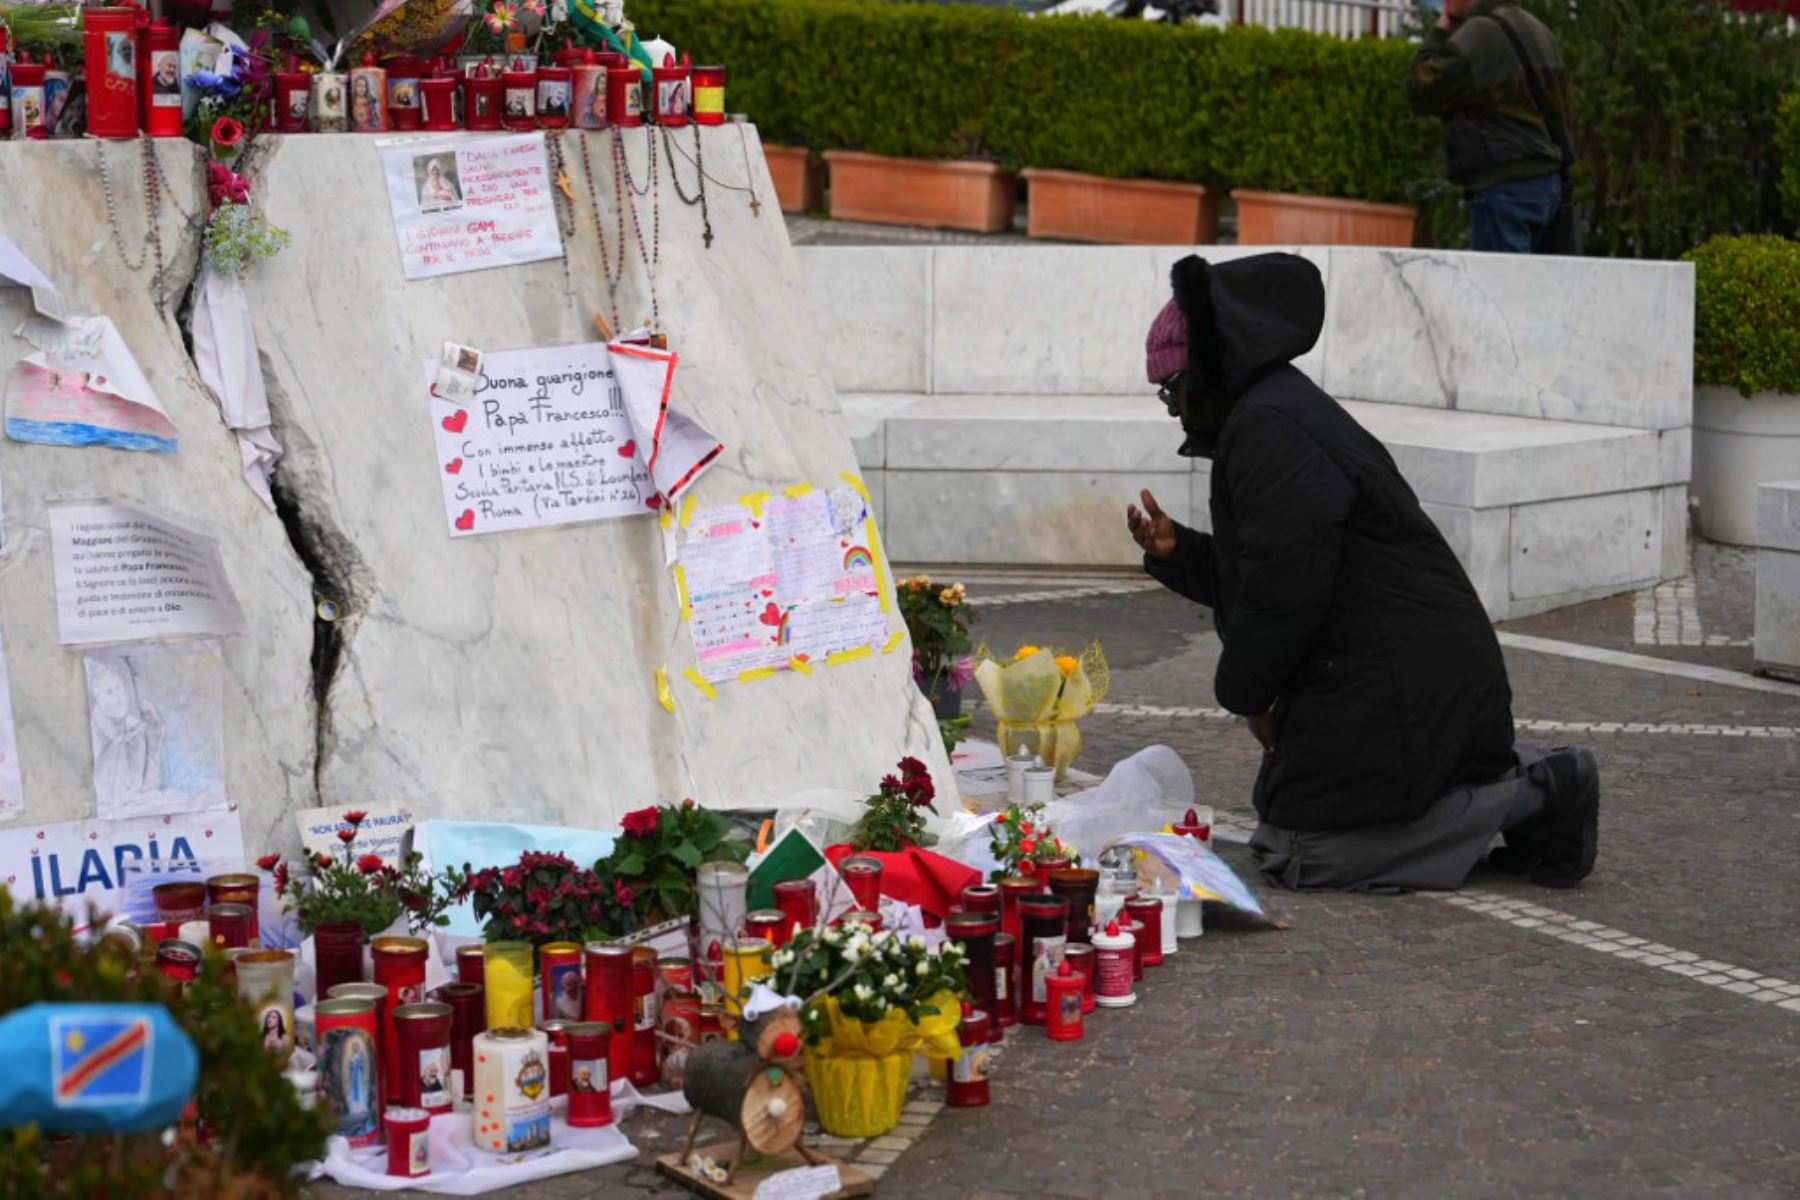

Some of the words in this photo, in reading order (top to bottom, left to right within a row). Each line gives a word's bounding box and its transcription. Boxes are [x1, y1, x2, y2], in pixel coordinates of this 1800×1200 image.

[467, 220, 496, 234] GAM
[535, 362, 615, 397] guarigione
[461, 440, 492, 458] Con
[498, 441, 554, 456] immenso
[560, 428, 615, 456] affetto
[491, 460, 522, 477] bimbi
[529, 465, 536, 474] e
[455, 482, 500, 501] Scuola
[478, 499, 523, 520] Roma
